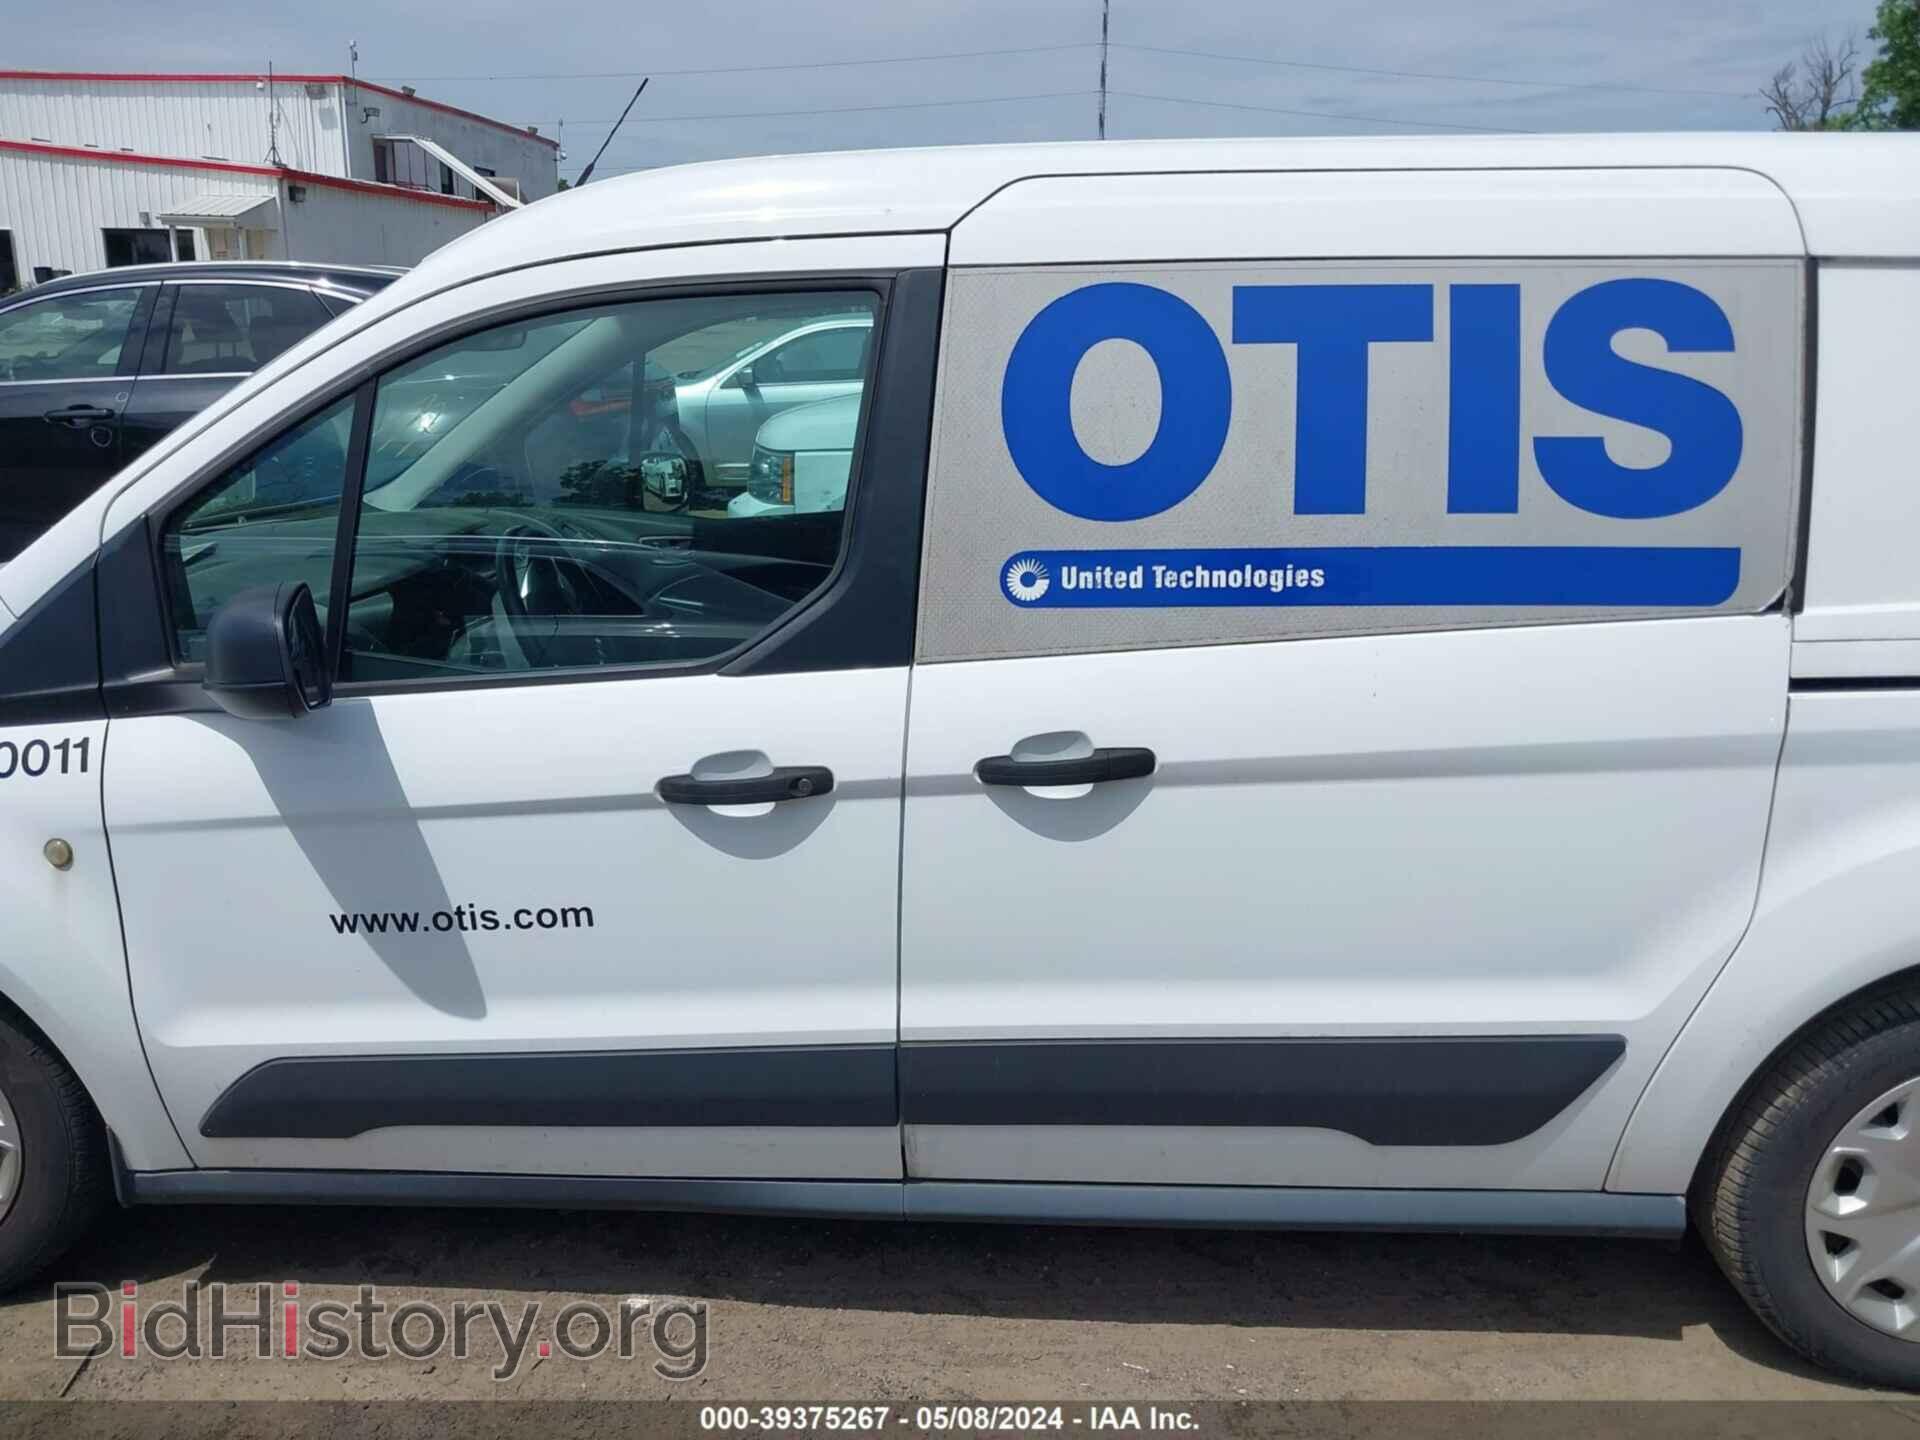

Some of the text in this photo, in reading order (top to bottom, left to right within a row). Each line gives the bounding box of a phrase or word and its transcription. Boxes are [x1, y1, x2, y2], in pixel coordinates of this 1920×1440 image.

[1001, 277, 1744, 523] OTIS
[1061, 564, 1326, 593] United Technologies
[329, 902, 595, 934] www.otis.com
